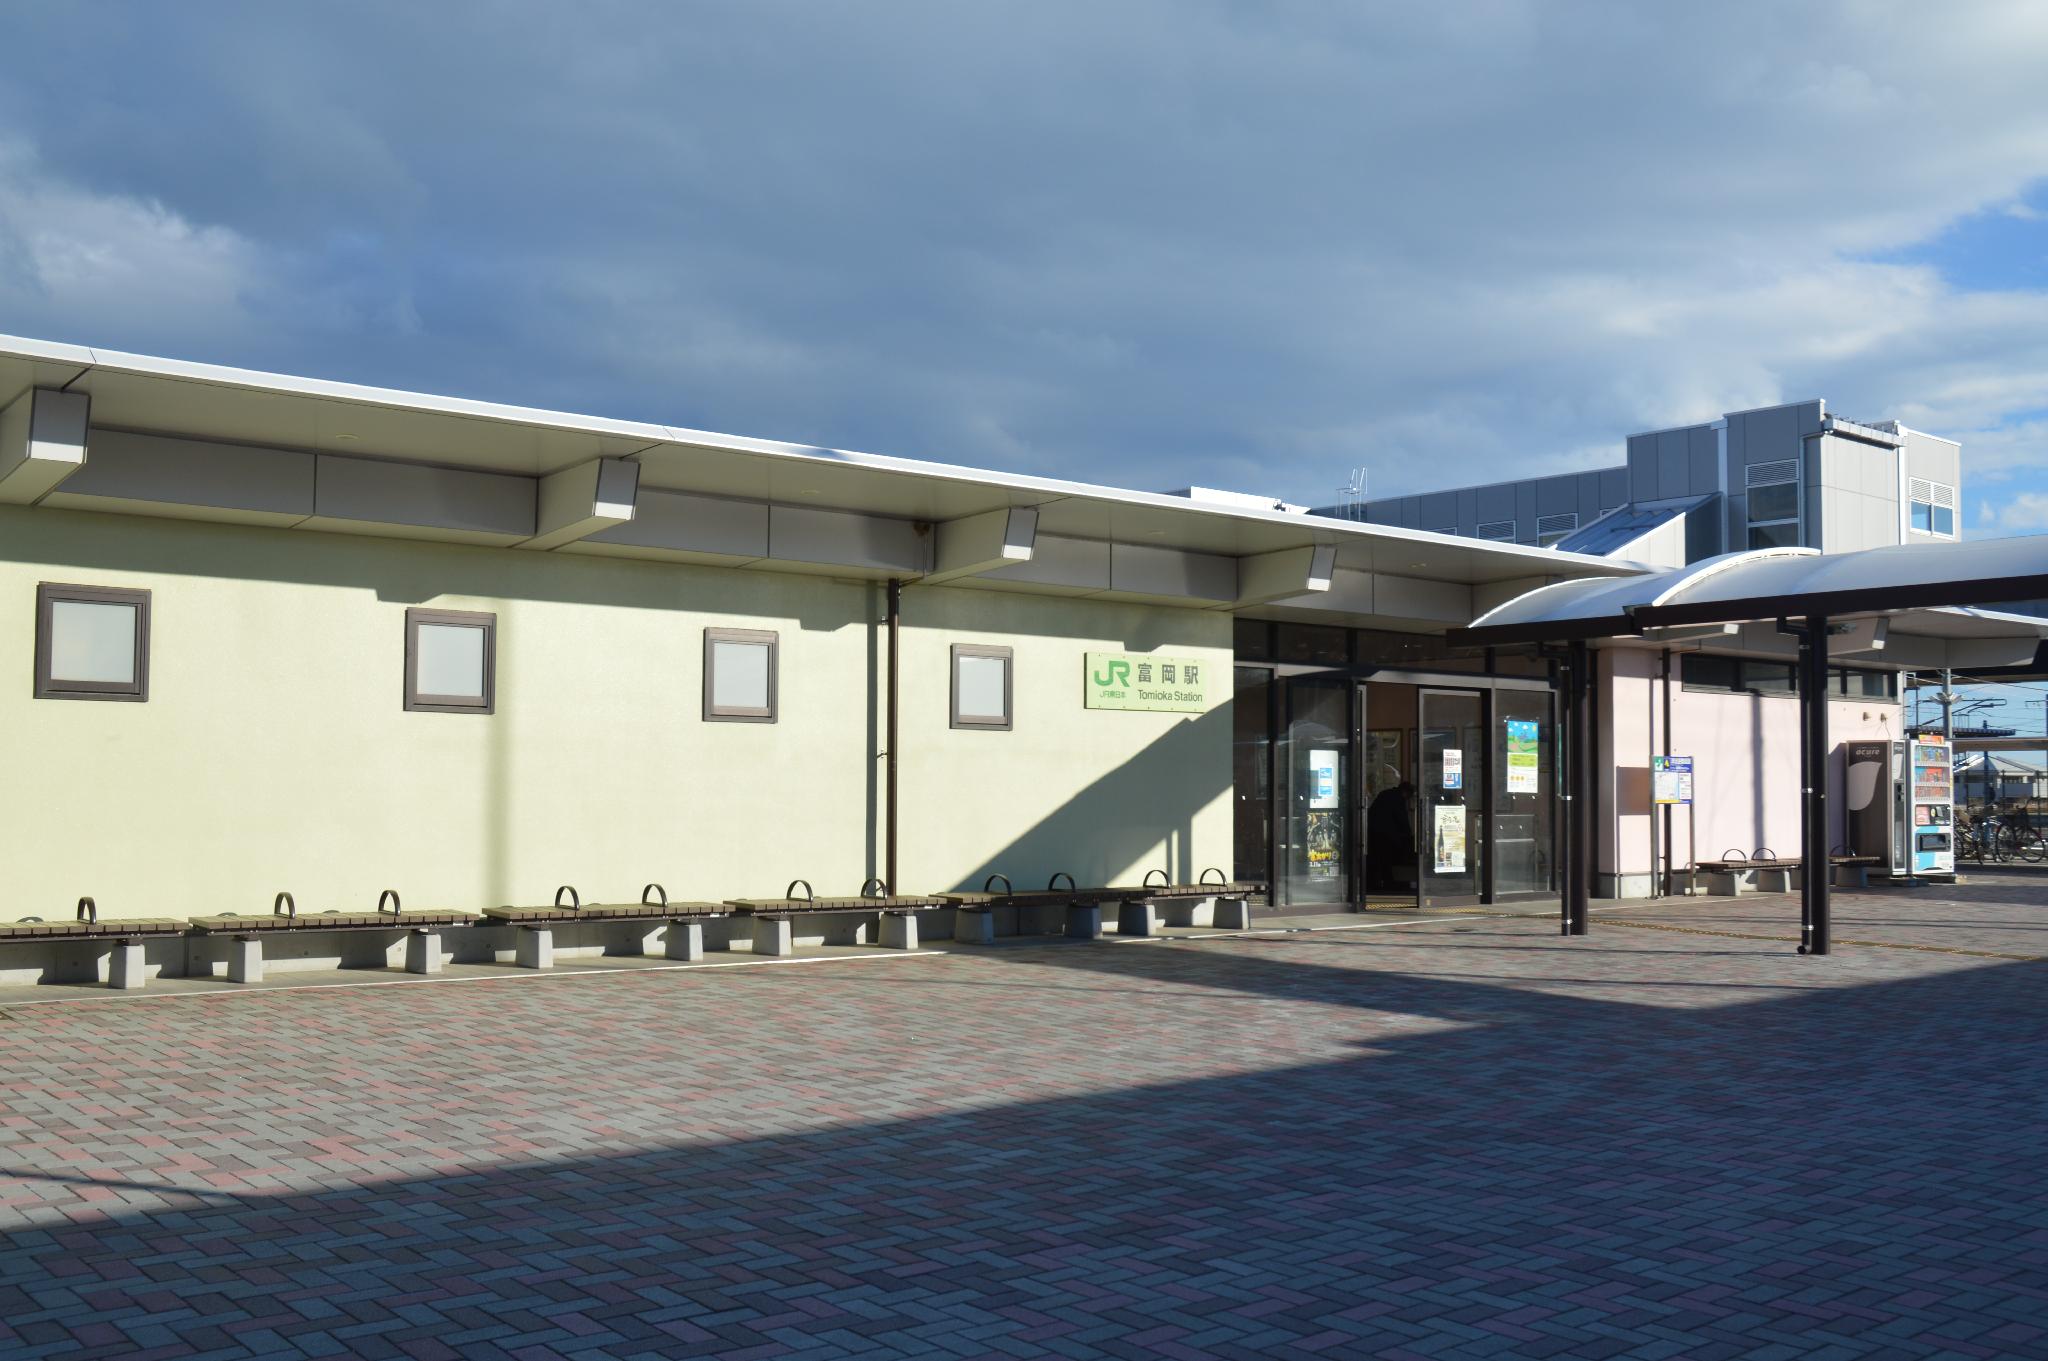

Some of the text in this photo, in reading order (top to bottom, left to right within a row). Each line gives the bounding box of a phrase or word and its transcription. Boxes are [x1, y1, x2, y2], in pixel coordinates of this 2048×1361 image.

[1094, 660, 1131, 688] JR
[1138, 663, 1199, 685] 富岡駅
[1099, 690, 1126, 699] JR東日本
[1137, 689, 1203, 702] Tomioka Station
